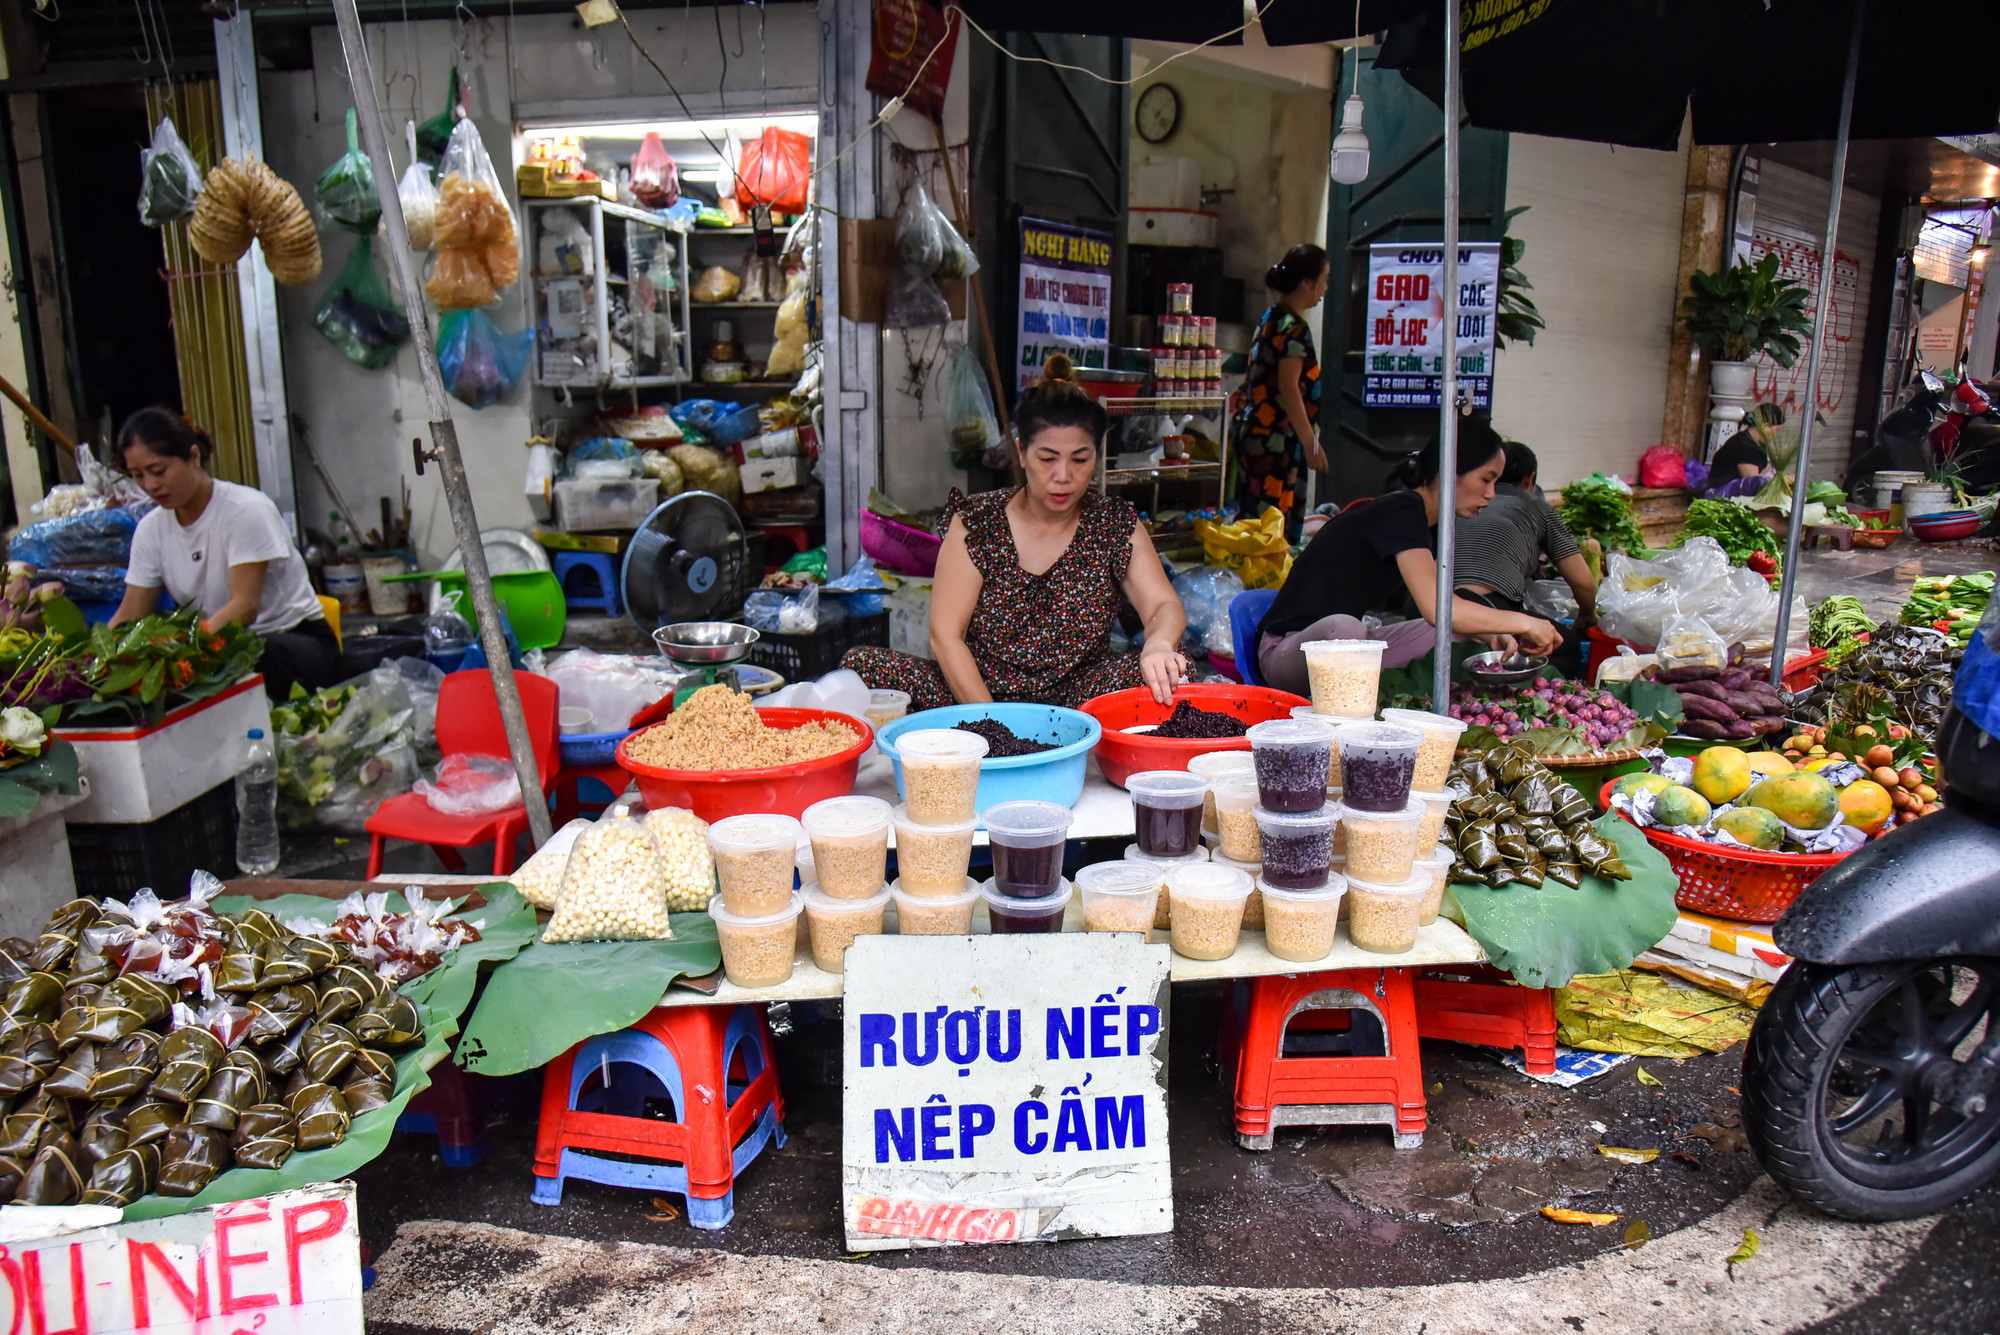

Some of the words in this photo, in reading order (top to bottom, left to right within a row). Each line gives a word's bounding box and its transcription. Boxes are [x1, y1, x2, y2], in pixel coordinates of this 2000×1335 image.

[1024, 229, 1065, 265] NGHỊ
[1398, 249, 1473, 264] CHUYN
[1376, 274, 1430, 307] GẠO
[1460, 279, 1486, 307] CÁC
[1457, 315, 1486, 343] LOẠI
[1381, 378, 1391, 389] 12
[1377, 394, 1391, 405] 024
[860, 1005, 1021, 1077] RƯỢU
[1046, 986, 1160, 1060] NẾP
[874, 1094, 995, 1163] NÊP
[1013, 1072, 1146, 1155] CẨM
